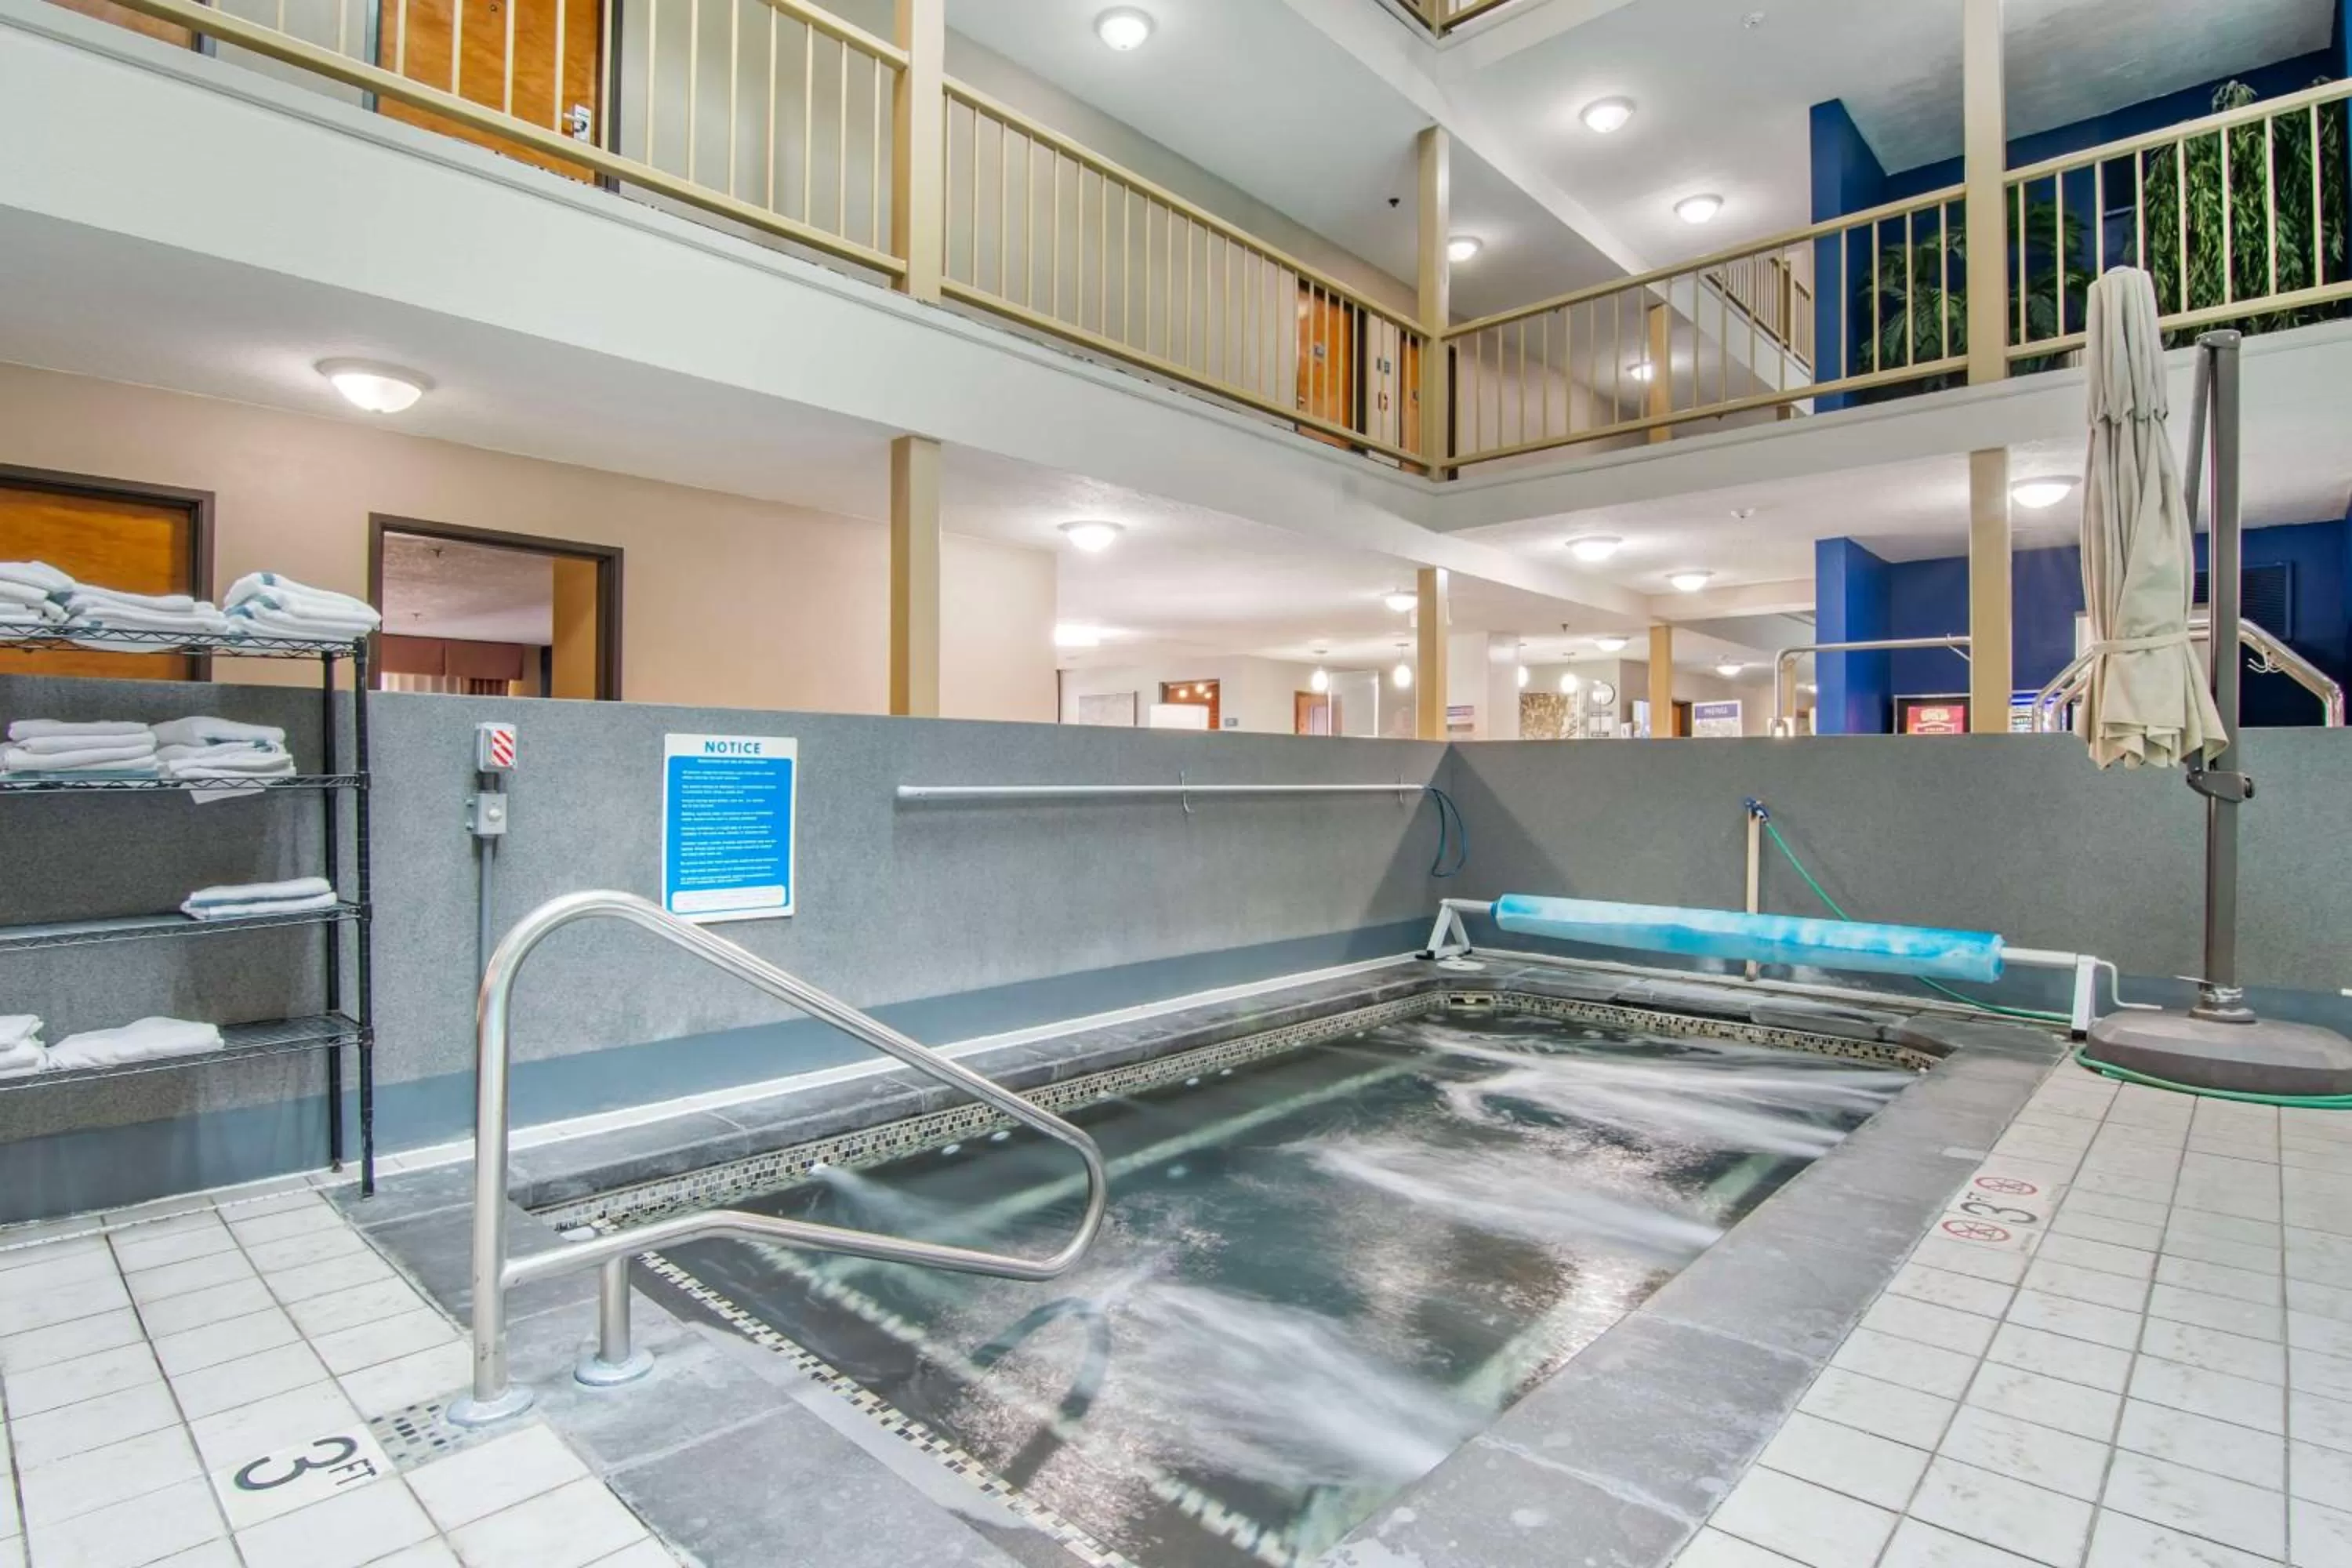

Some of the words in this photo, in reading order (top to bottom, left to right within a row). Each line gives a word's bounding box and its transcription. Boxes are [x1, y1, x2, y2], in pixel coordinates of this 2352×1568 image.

[704, 741, 762, 754] NOTICE
[1961, 1202, 2037, 1223] 3
[234, 1436, 358, 1490] 3
[328, 1457, 376, 1486] FT
